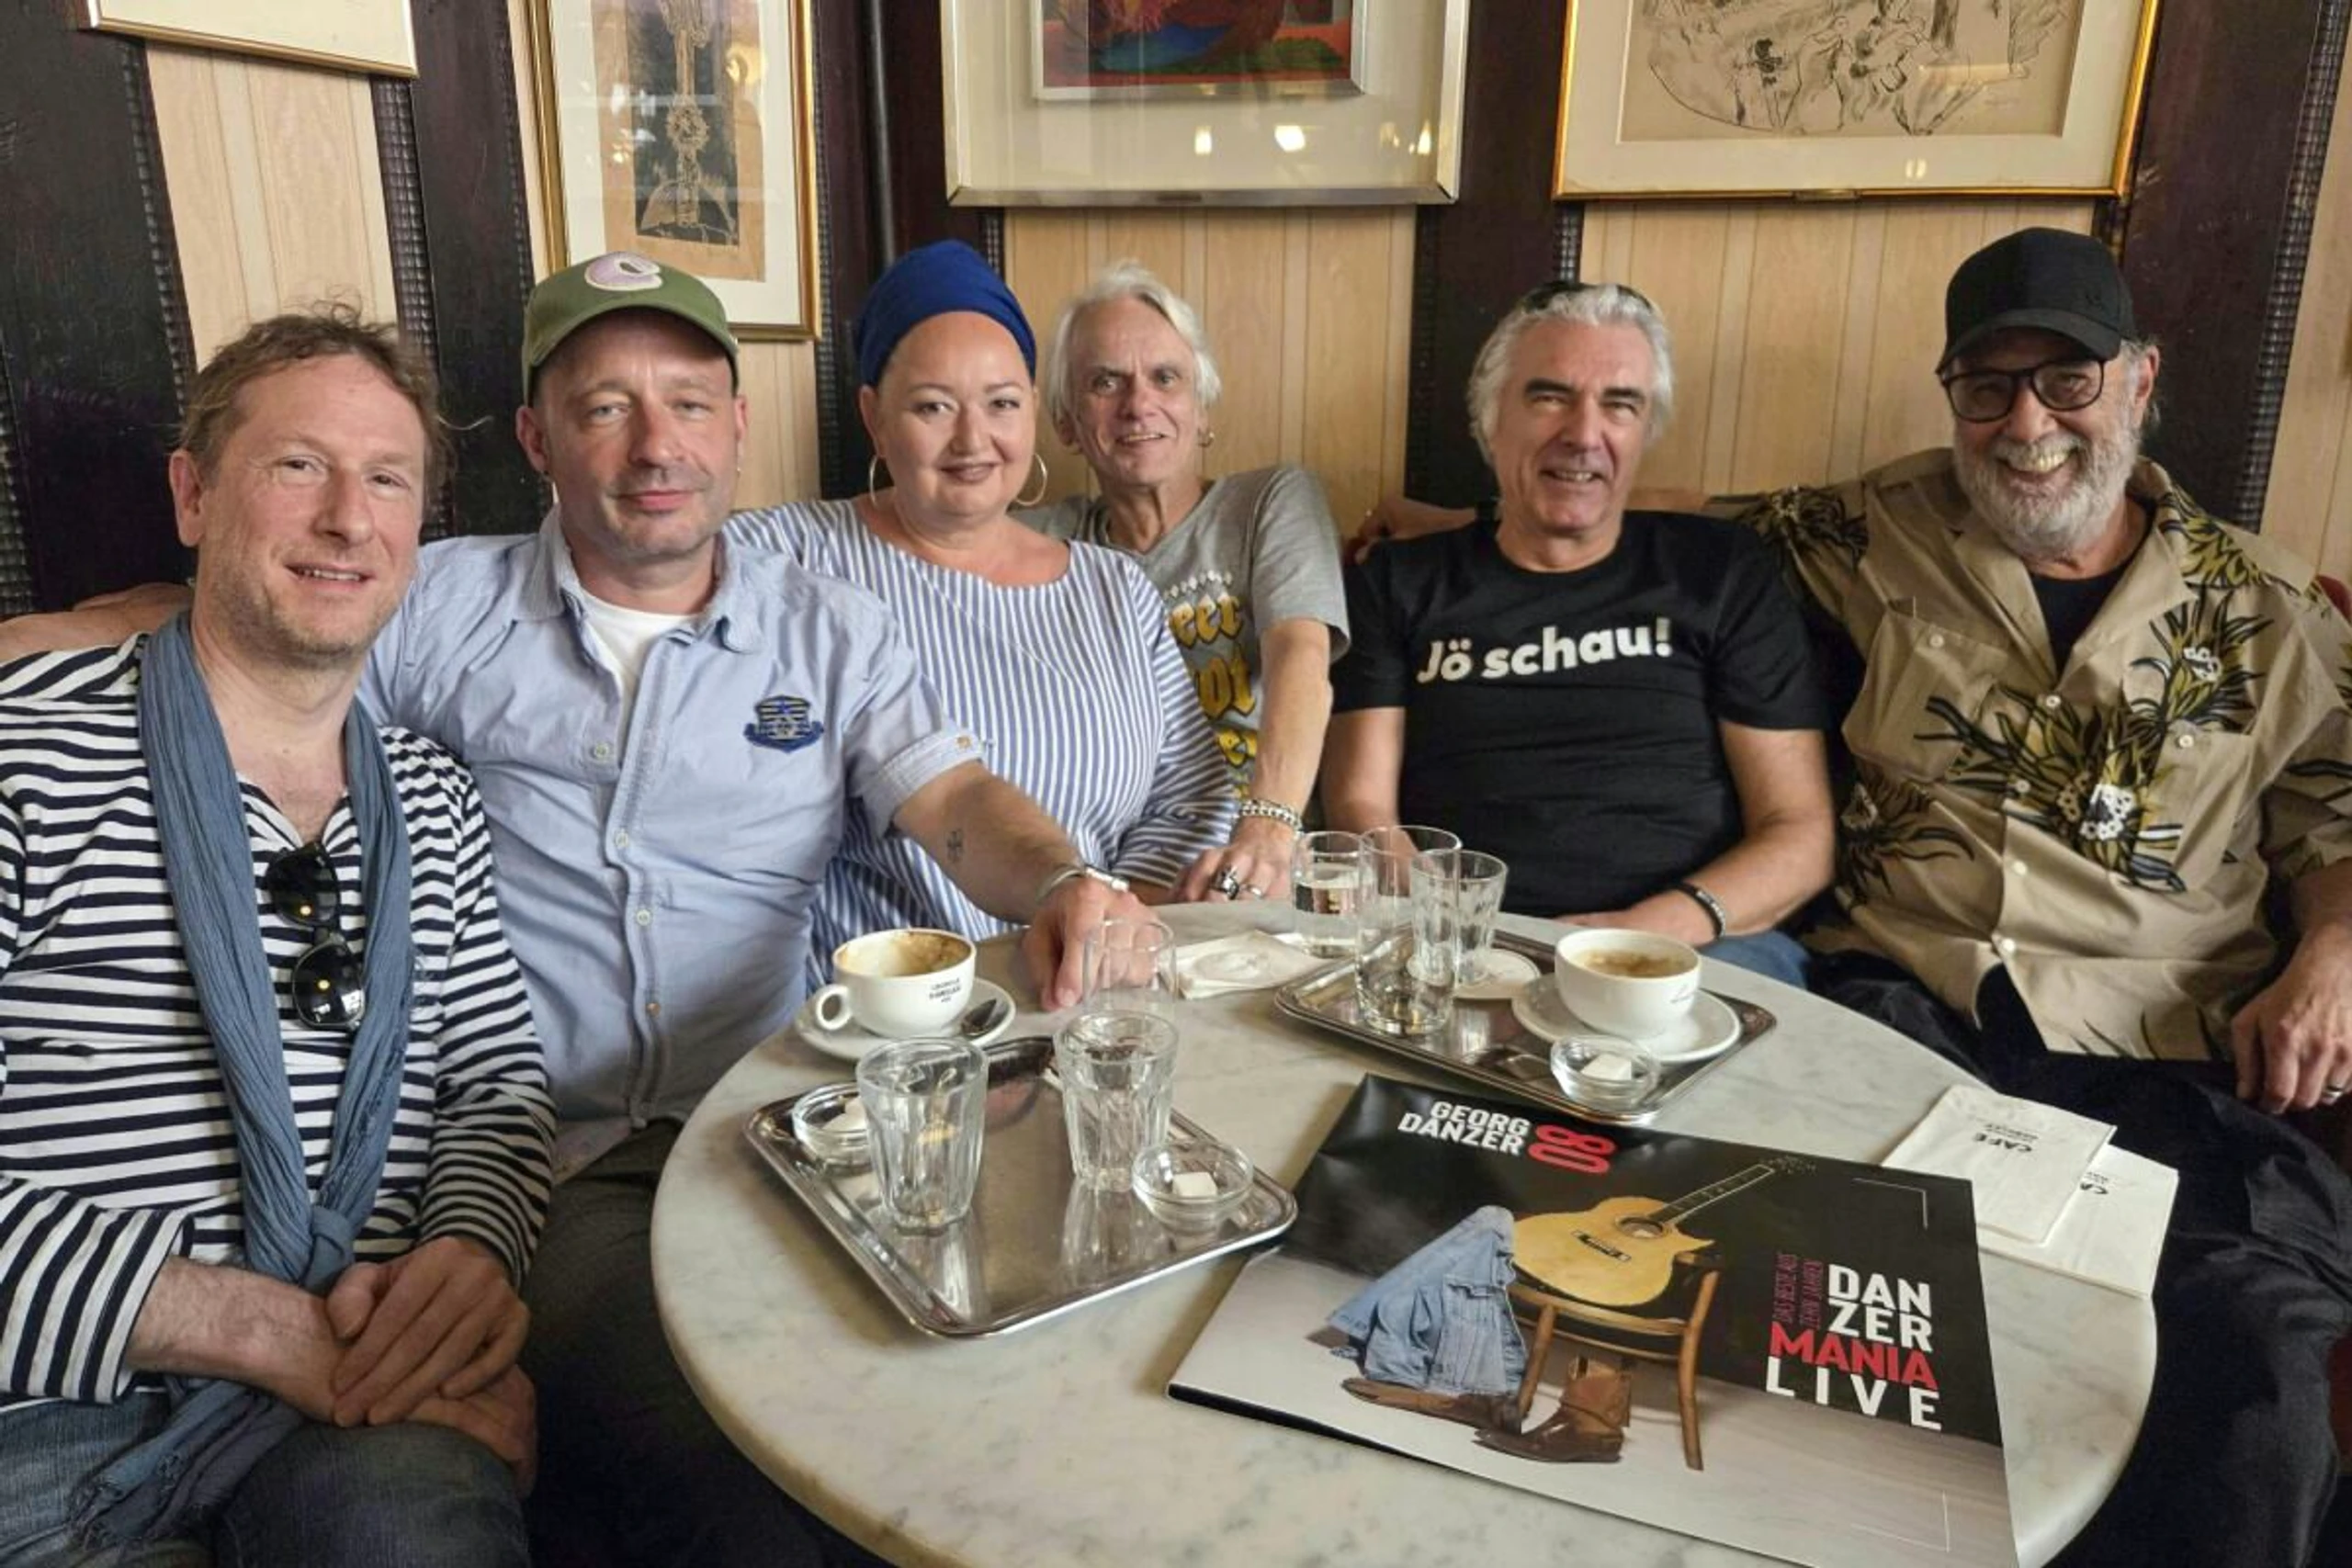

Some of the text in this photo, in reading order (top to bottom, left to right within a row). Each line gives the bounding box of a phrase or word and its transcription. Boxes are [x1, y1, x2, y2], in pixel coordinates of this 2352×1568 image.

[1417, 616, 1672, 682] Jö schau!
[1397, 1112, 1525, 1155] DANZER
[1430, 1101, 1532, 1136] GEORG
[1828, 1263, 1932, 1317] DAN
[1828, 1297, 1933, 1352] ZER
[1770, 1321, 1938, 1391] MANIA
[1766, 1356, 1941, 1431] LIVE
